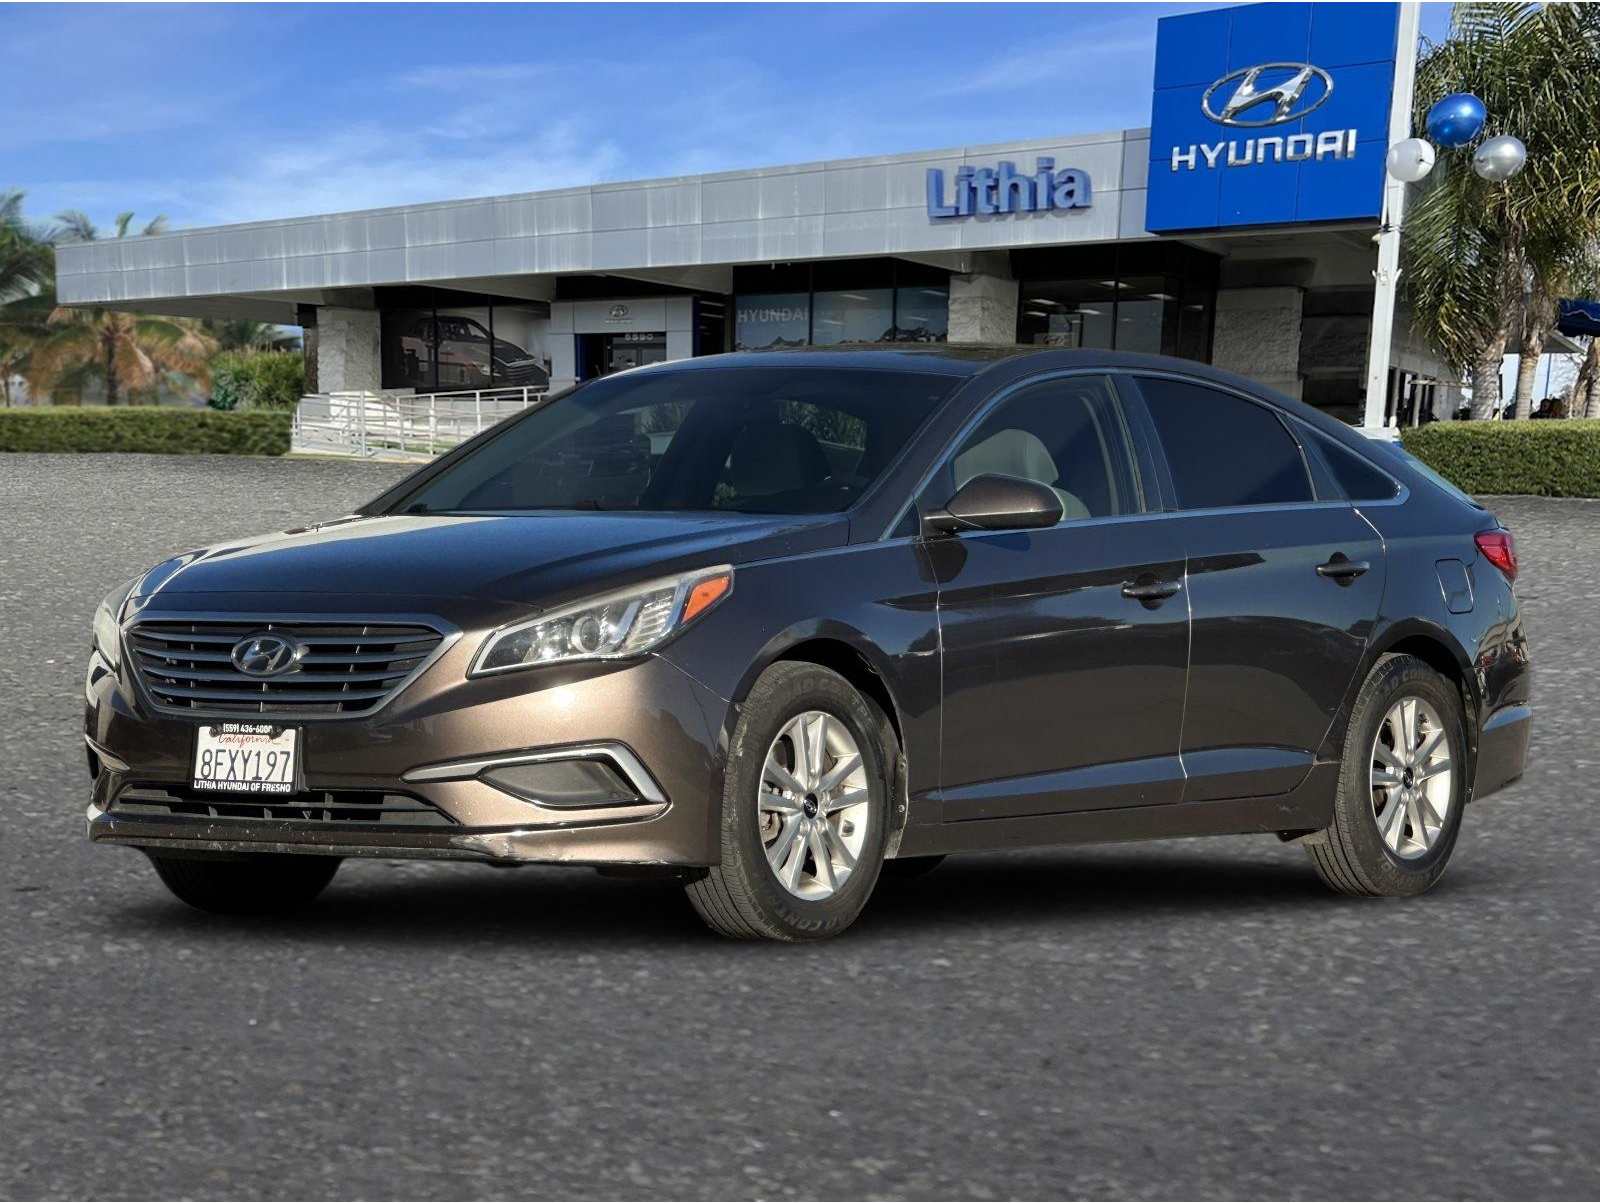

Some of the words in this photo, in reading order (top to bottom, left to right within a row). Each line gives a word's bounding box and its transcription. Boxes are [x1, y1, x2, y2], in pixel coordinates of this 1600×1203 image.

[1171, 129, 1357, 172] HYUNDAI
[926, 156, 1092, 219] Lithia
[737, 306, 809, 323] HYUNDAI
[223, 723, 239, 733] (559)
[201, 749, 290, 781] 8FXY197
[193, 780, 217, 790] LITHIA
[217, 781, 249, 791] HYUNDAI
[250, 782, 260, 791] OF
[261, 783, 291, 793] FRESNO
